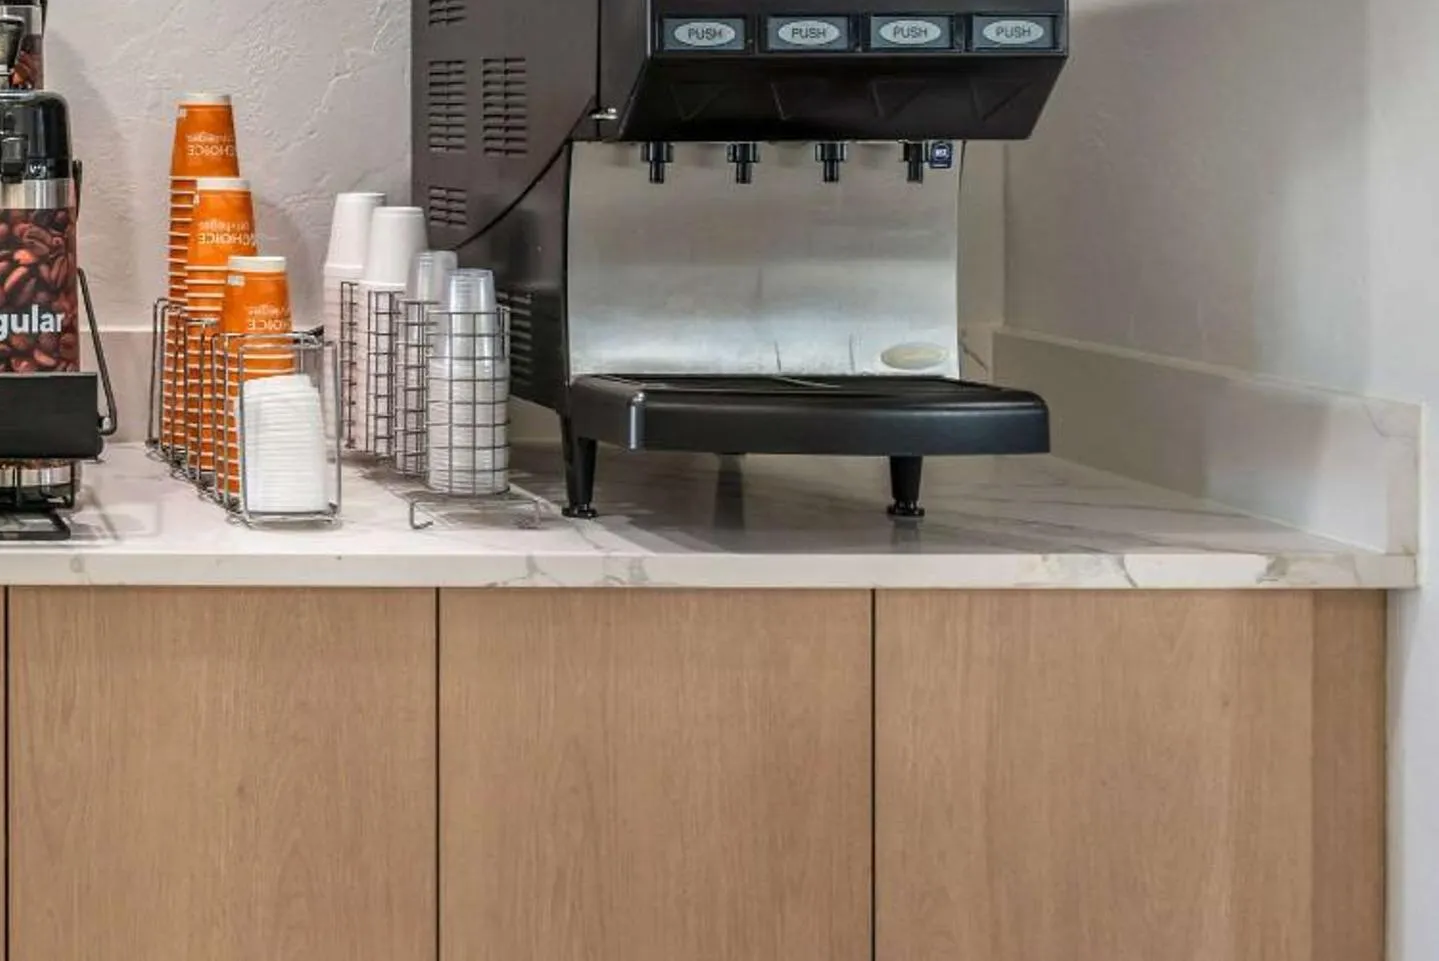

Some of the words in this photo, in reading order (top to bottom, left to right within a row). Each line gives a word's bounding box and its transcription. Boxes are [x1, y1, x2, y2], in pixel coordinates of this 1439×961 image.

[687, 27, 723, 40] PUSH
[791, 27, 827, 39] PUSH
[892, 25, 928, 39] PUSH
[995, 25, 1031, 39] PUSH
